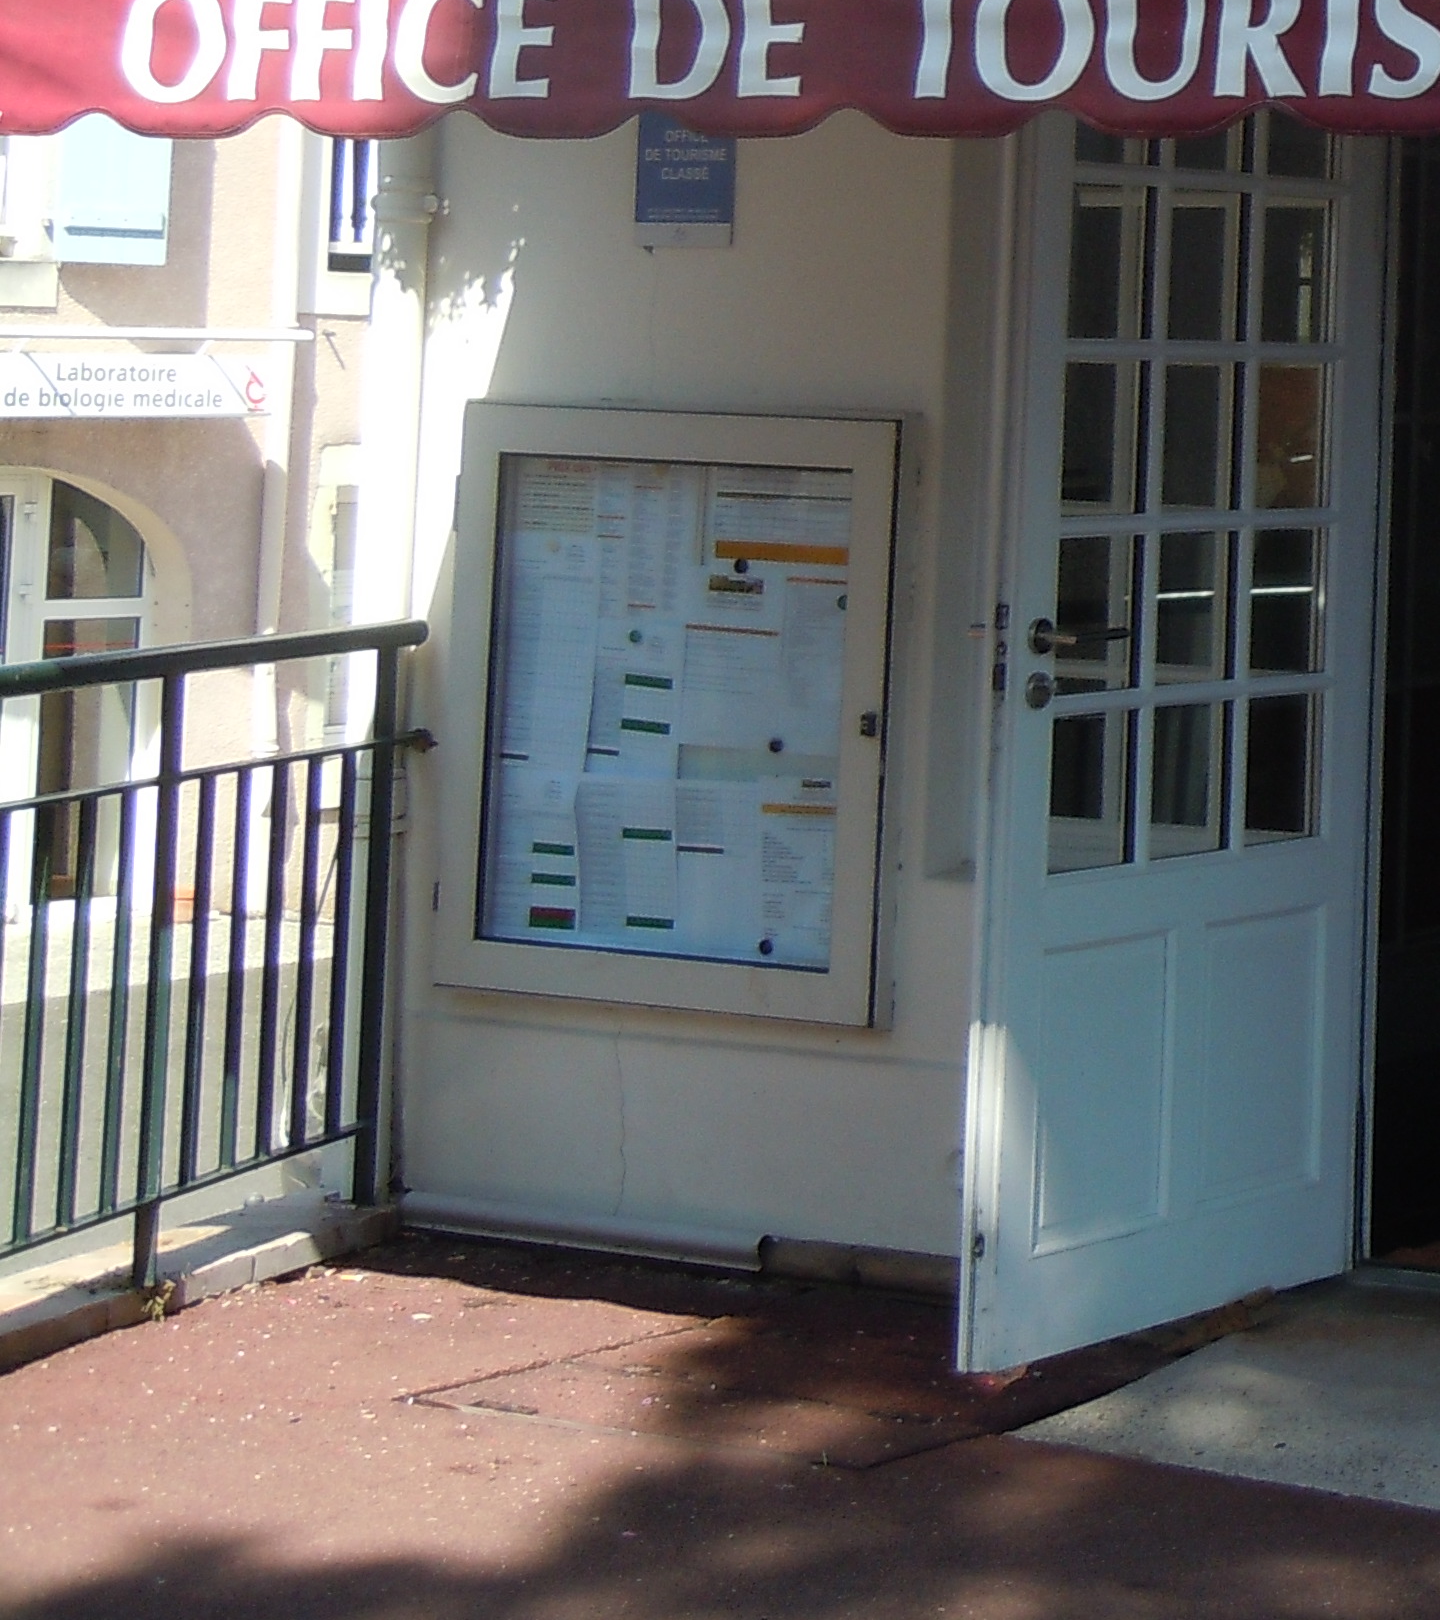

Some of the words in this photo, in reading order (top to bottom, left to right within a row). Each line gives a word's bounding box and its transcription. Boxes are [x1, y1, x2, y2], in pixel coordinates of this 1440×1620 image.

[645, 149, 661, 161] DE
[665, 148, 727, 161] TOURISME
[56, 362, 177, 383] Laboratoire
[4, 387, 30, 407] de
[38, 387, 125, 412] biologie
